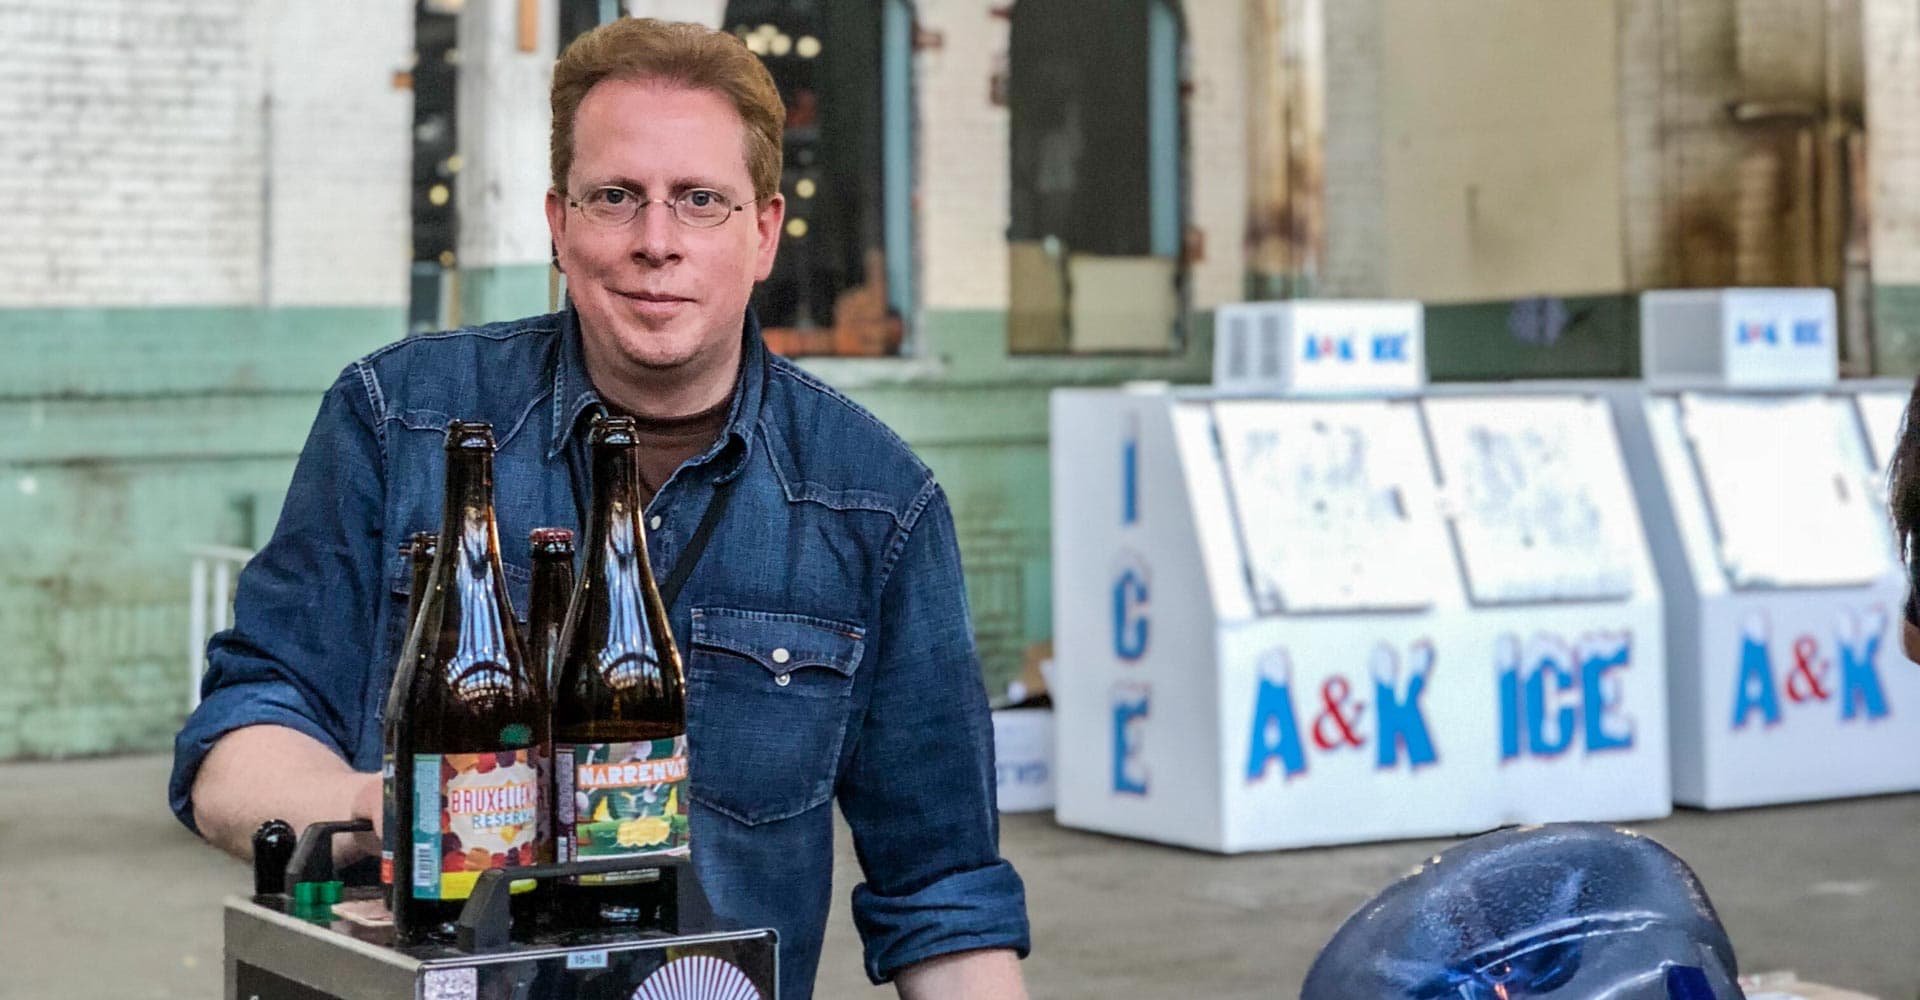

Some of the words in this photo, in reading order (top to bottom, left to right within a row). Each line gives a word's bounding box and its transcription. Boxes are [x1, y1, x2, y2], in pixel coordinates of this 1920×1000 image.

[1303, 330, 1355, 363] A&K
[1112, 412, 1152, 797] ICE
[1731, 605, 1891, 730] A&K
[1244, 640, 1438, 783] A&K
[1497, 630, 1634, 766] ICE
